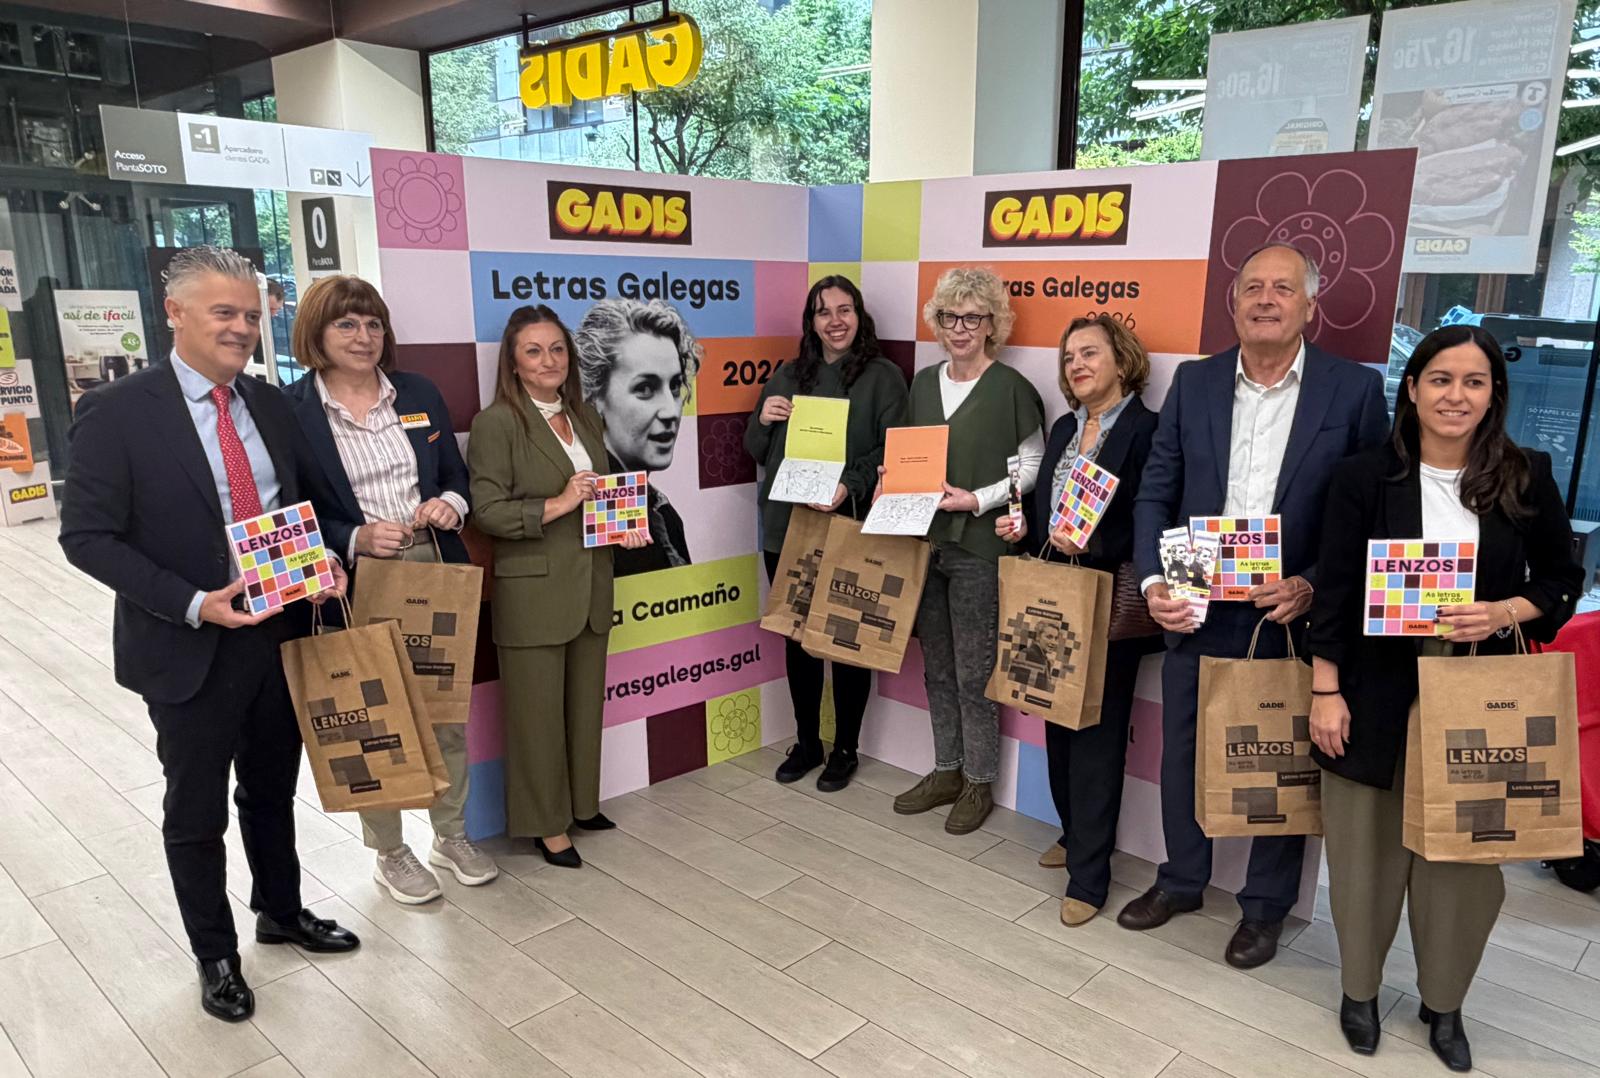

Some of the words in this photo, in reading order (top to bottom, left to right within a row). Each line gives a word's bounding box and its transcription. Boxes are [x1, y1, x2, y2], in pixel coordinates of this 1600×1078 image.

[193, 127, 211, 145] -1
[114, 150, 145, 160] Acceso
[115, 161, 167, 174] PlantaSOTO
[314, 171, 322, 182] P
[554, 188, 688, 238] GADIS
[989, 191, 1125, 241] GADIS
[492, 270, 607, 302] Letras
[618, 271, 740, 307] Galegas
[1043, 276, 1140, 304] Galegas
[84, 310, 101, 320] de
[1, 396, 33, 405] PUNTO
[1071, 469, 1101, 497] LENZOS
[12, 484, 46, 501] GADIS
[595, 486, 635, 500] ENZOS
[238, 524, 303, 554] LENZOS
[1220, 533, 1262, 545] NZOS
[1374, 559, 1454, 572] LENZOS
[831, 581, 879, 602] LENZOS
[632, 583, 740, 621] Caamaño
[403, 635, 431, 647] ZOS
[604, 644, 761, 701] rasgalegas.gal
[313, 710, 368, 730] LENZOS
[1228, 743, 1292, 756] LENZOS
[1449, 748, 1526, 763] LENZOS
